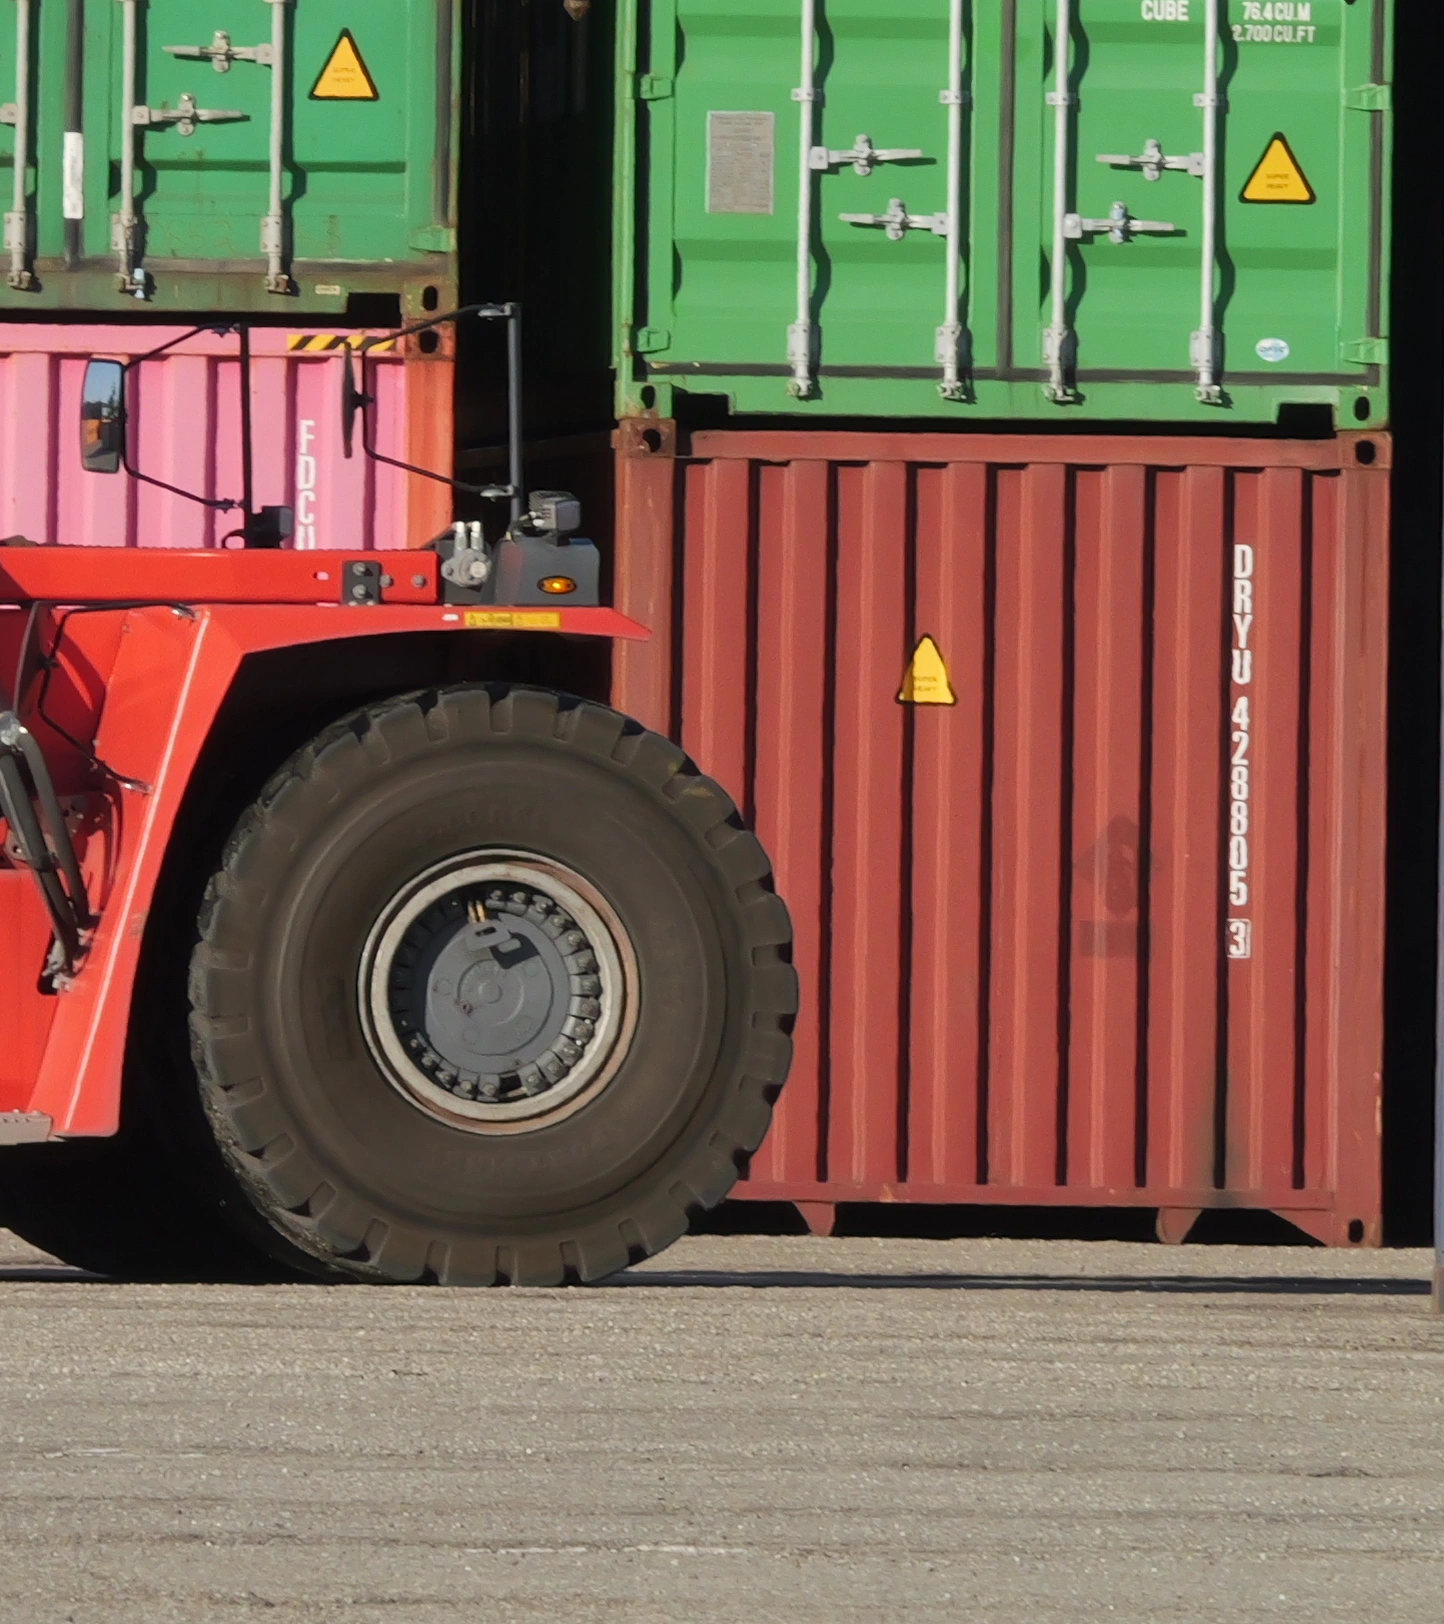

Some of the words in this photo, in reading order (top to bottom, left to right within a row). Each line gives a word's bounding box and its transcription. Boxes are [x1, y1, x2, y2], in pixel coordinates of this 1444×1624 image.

[1141, 0, 1190, 21] CUBE
[1242, 2, 1273, 21] 76.4
[1232, 24, 1273, 42] 2.700
[1232, 544, 1253, 685] DRYU
[1229, 696, 1249, 906] 428805
[1229, 919, 1249, 957] 3
